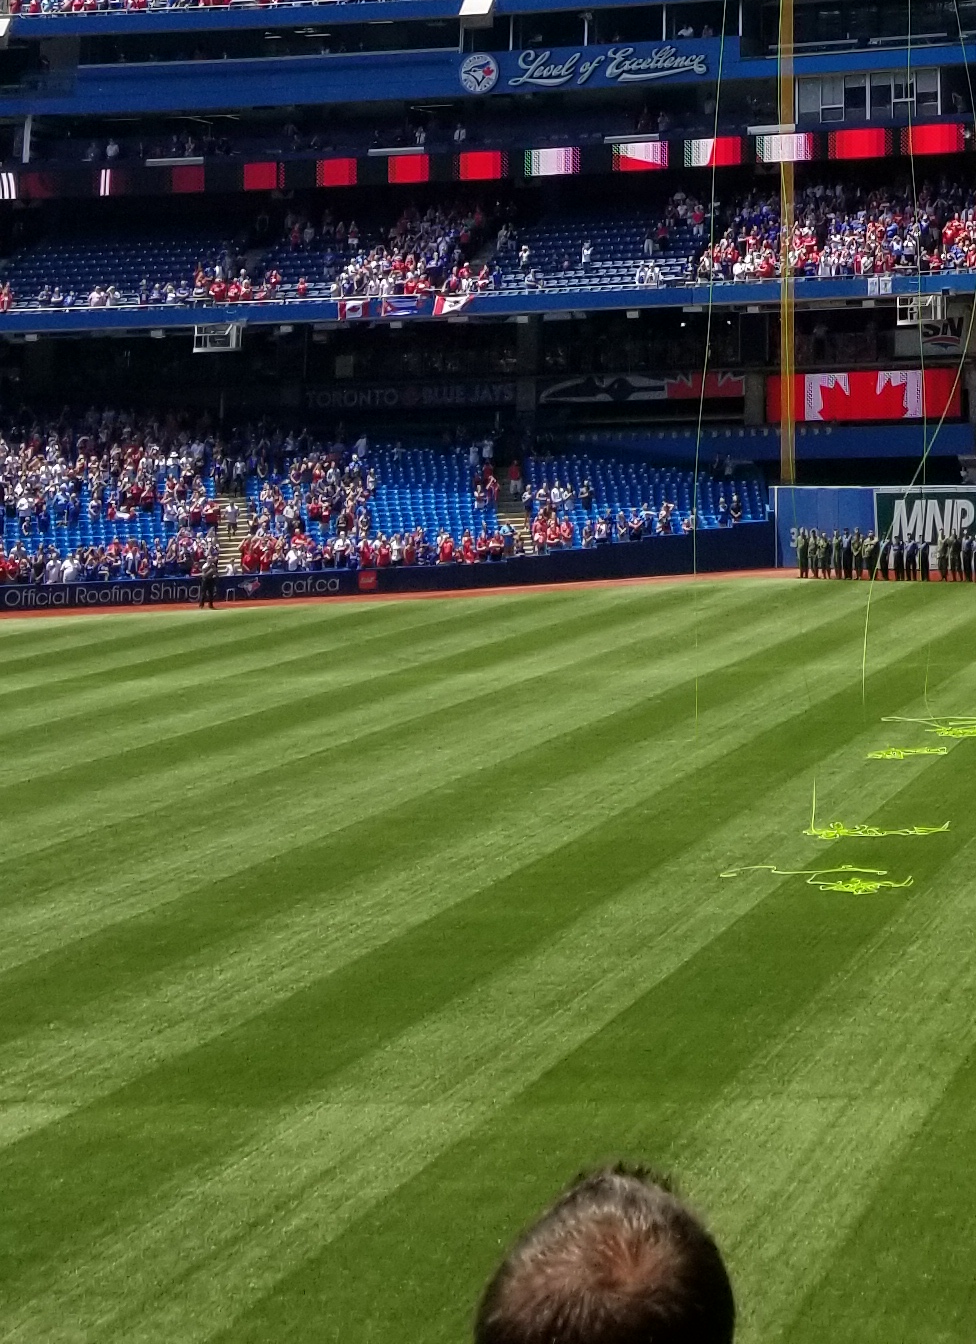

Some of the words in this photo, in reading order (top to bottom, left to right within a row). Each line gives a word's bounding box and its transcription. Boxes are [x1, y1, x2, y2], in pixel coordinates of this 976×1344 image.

[508, 50, 580, 86] Level
[577, 55, 605, 84] of
[606, 45, 707, 81] Excellence
[305, 388, 399, 407] TORONTO
[470, 383, 514, 402] JAYS
[892, 499, 975, 543] MNP
[4, 588, 69, 607] Official
[75, 585, 145, 605] Roofing
[281, 576, 340, 597] gaf.ca
